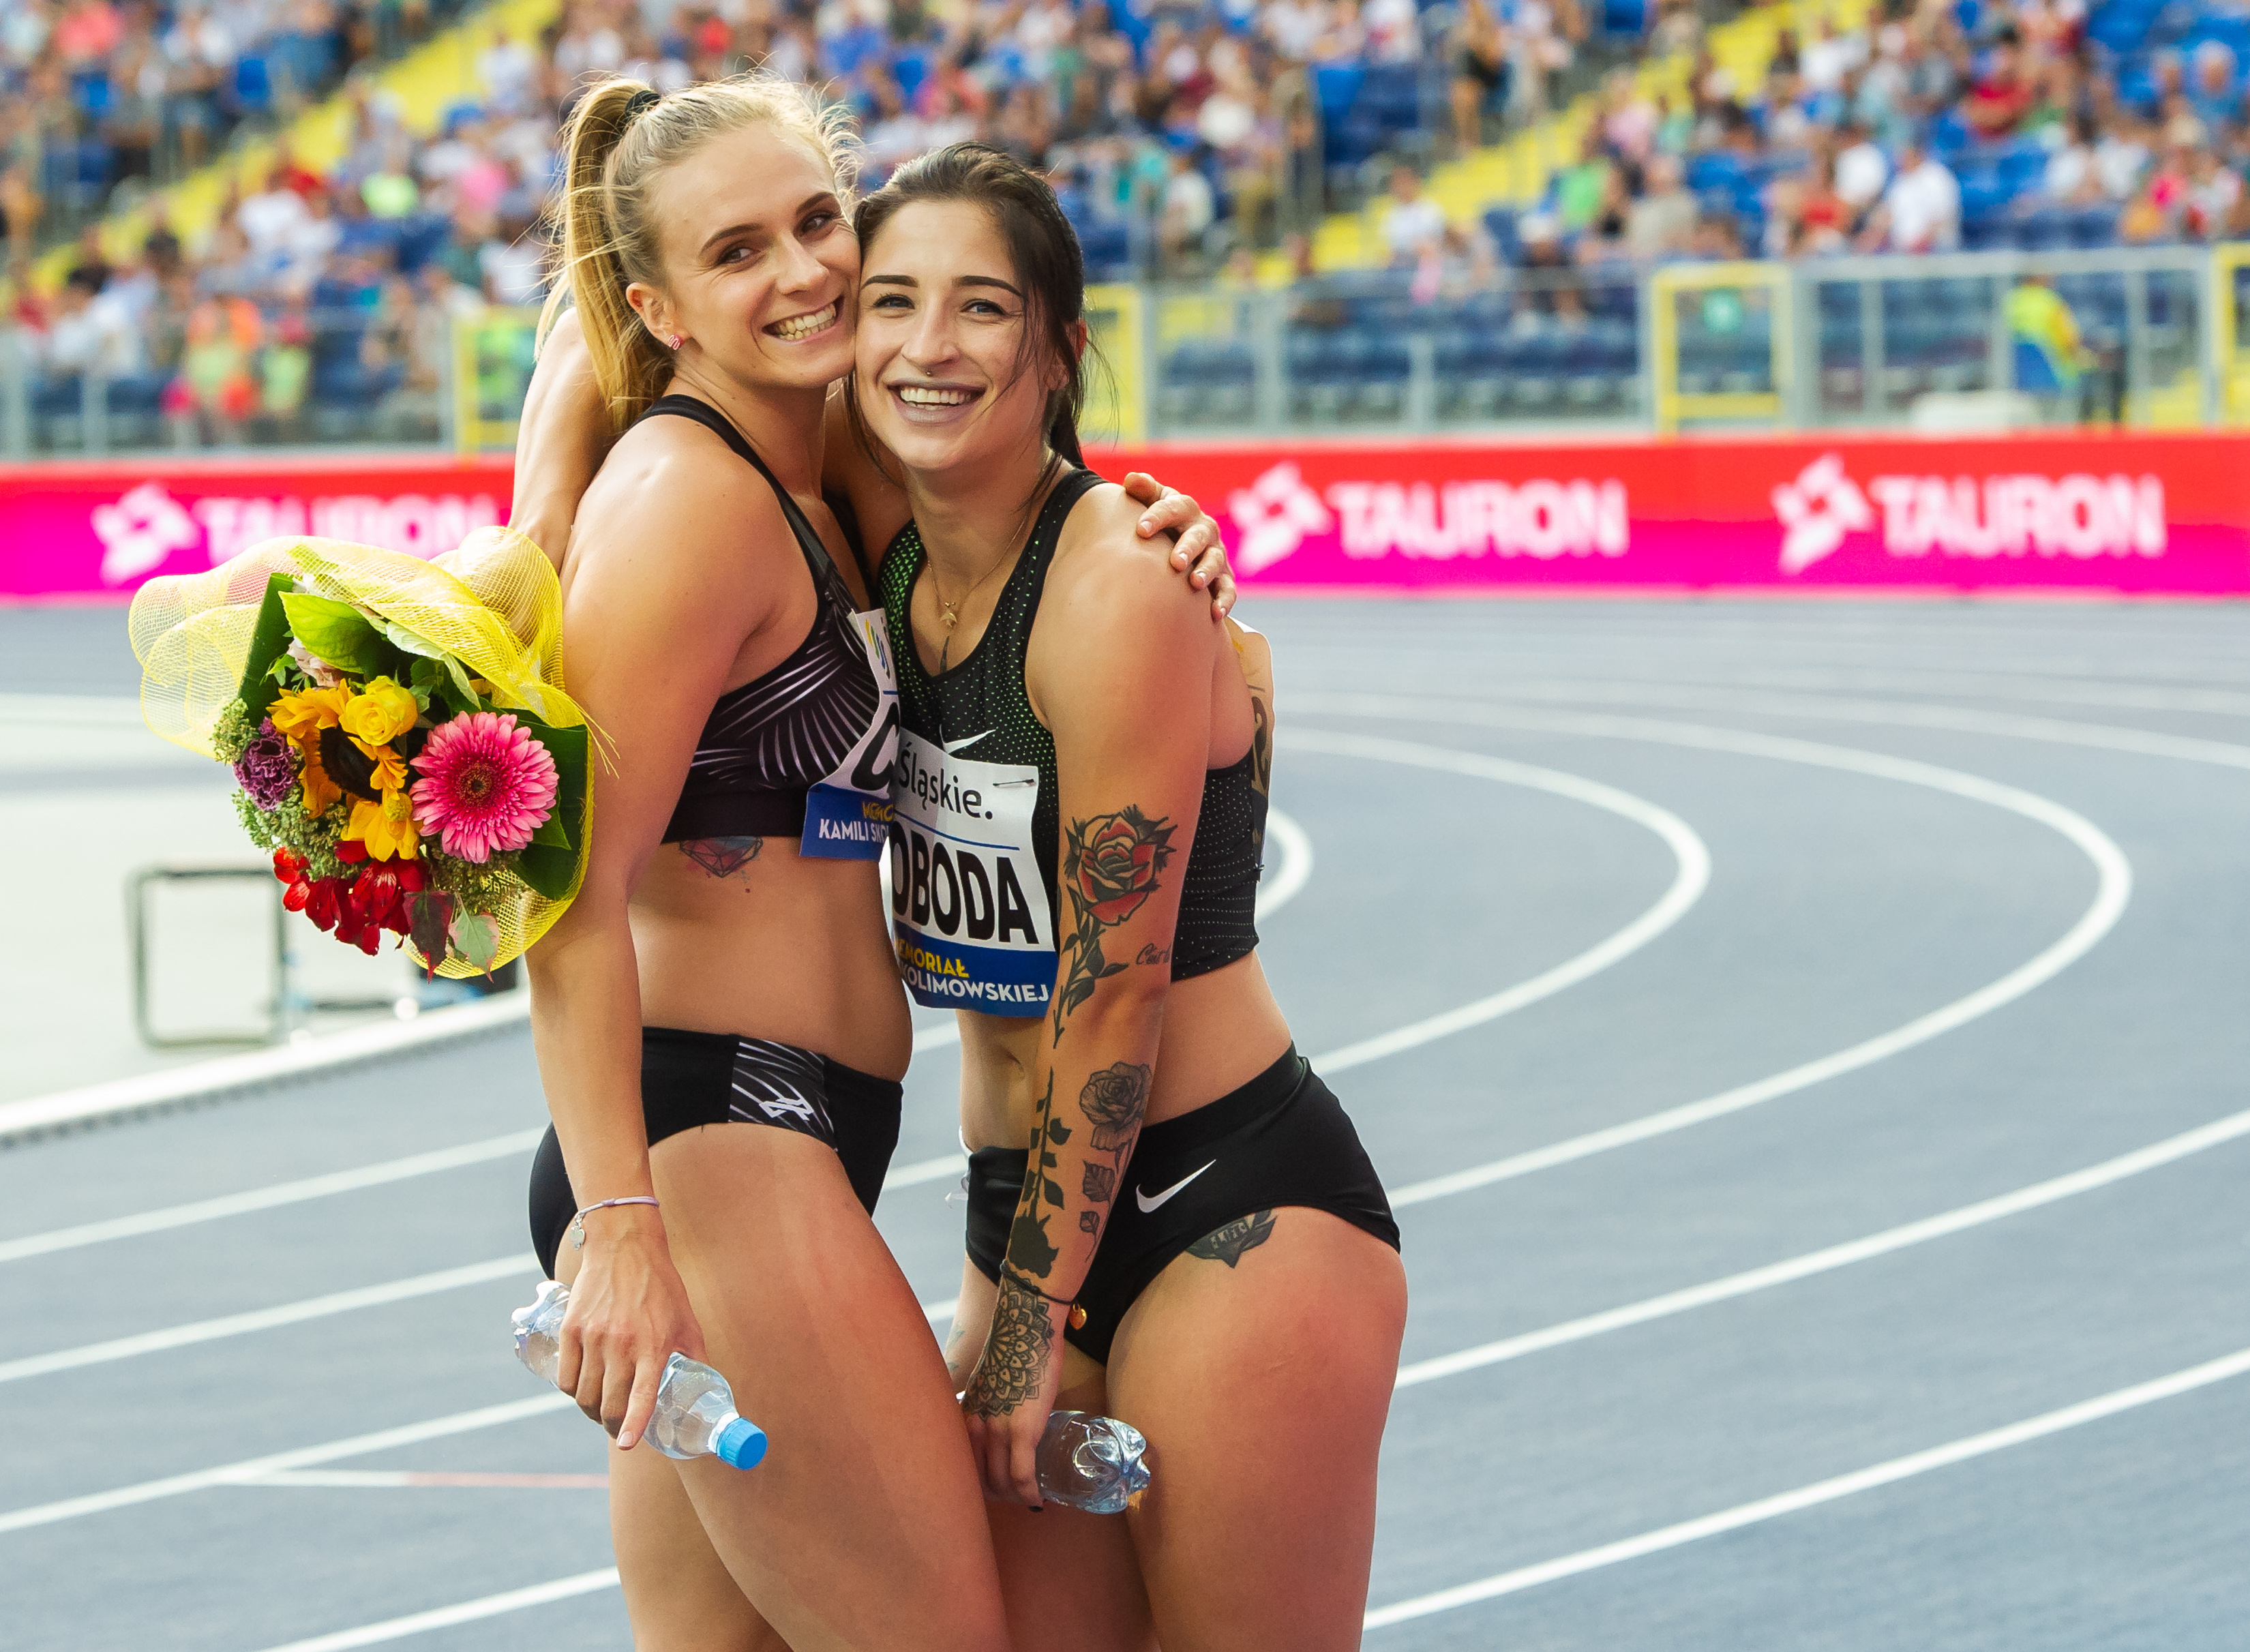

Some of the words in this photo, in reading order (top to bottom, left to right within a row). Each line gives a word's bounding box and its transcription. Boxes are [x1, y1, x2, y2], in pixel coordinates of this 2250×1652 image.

[1327, 480, 1627, 557] TAURON
[1870, 476, 2165, 556] TAURON
[899, 741, 993, 820] Śląskie.
[819, 818, 869, 841] KAMILI
[888, 820, 1040, 945] OBODA
[895, 937, 970, 979] EMORIAŁ
